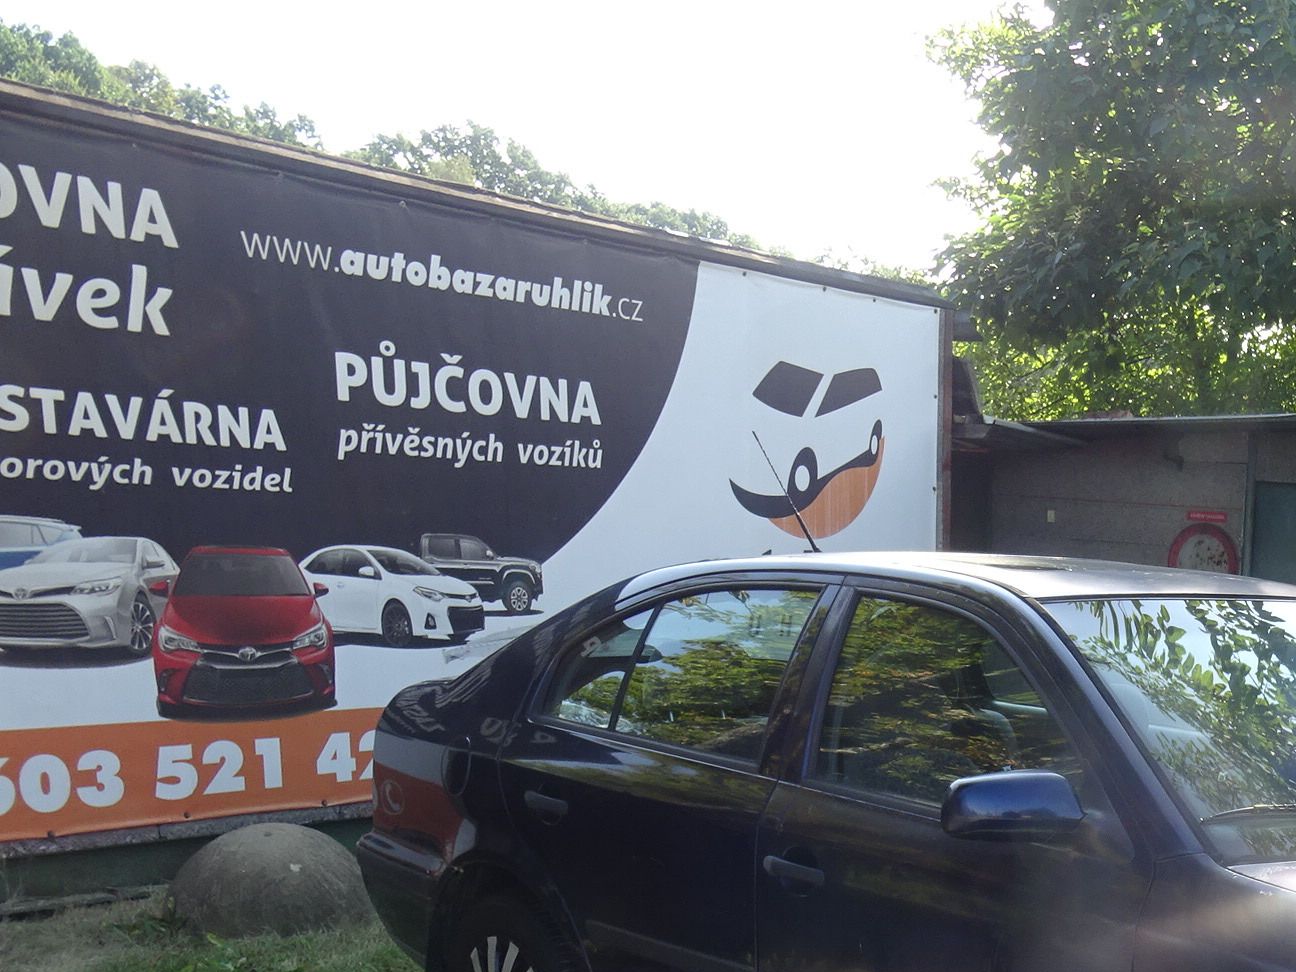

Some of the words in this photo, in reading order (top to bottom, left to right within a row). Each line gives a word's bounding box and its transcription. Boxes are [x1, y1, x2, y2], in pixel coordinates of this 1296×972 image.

[240, 230, 644, 322] www.autobazaruhlik.cz
[334, 340, 602, 425] PŮJČOVNA
[0, 384, 288, 452] STAVÁRNA
[337, 422, 504, 468] přívěsných
[517, 439, 603, 469] vozíků
[0, 455, 153, 491] orových
[172, 464, 293, 493] vozidel
[155, 736, 284, 800] 521
